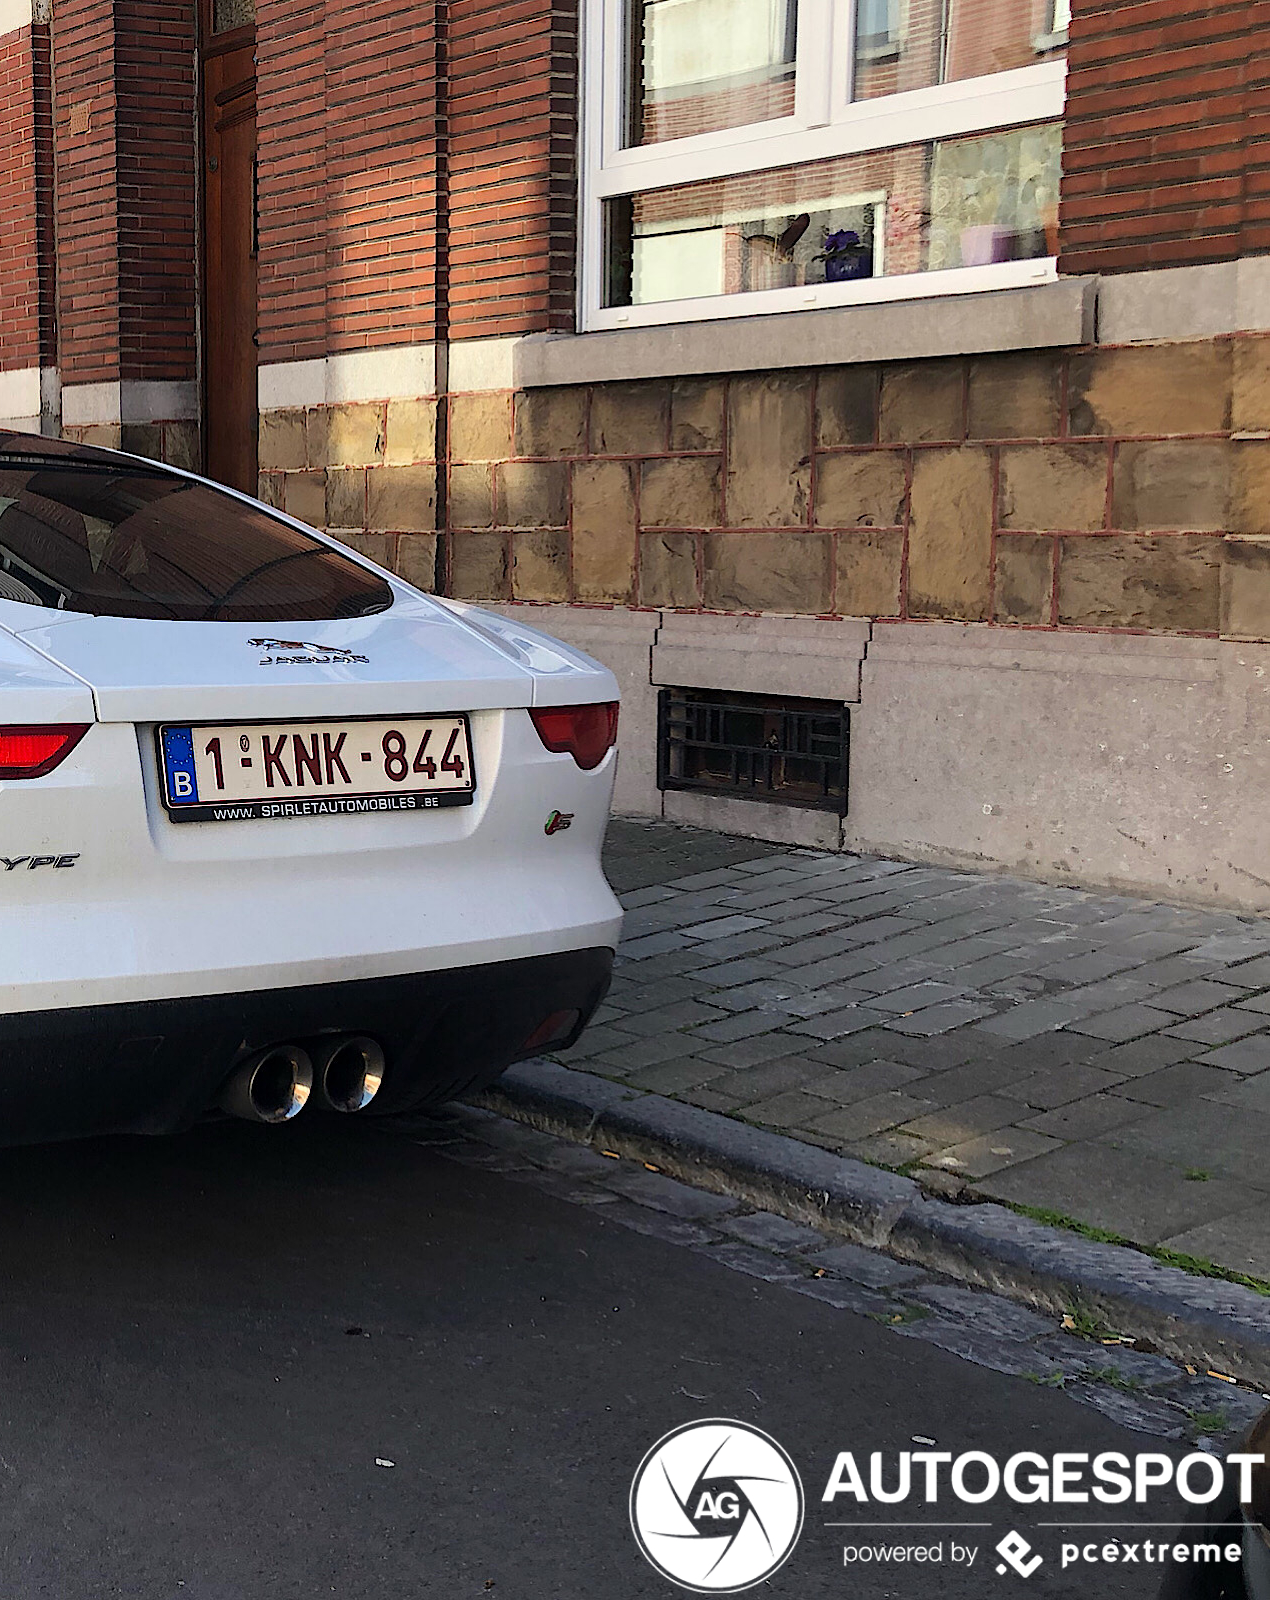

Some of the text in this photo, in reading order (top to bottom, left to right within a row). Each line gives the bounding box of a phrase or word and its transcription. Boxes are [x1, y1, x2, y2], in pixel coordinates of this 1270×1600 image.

[173, 771, 193, 798] B
[261, 796, 416, 818] SPIRLETAUTOMOBILES
[420, 797, 439, 808] .BE
